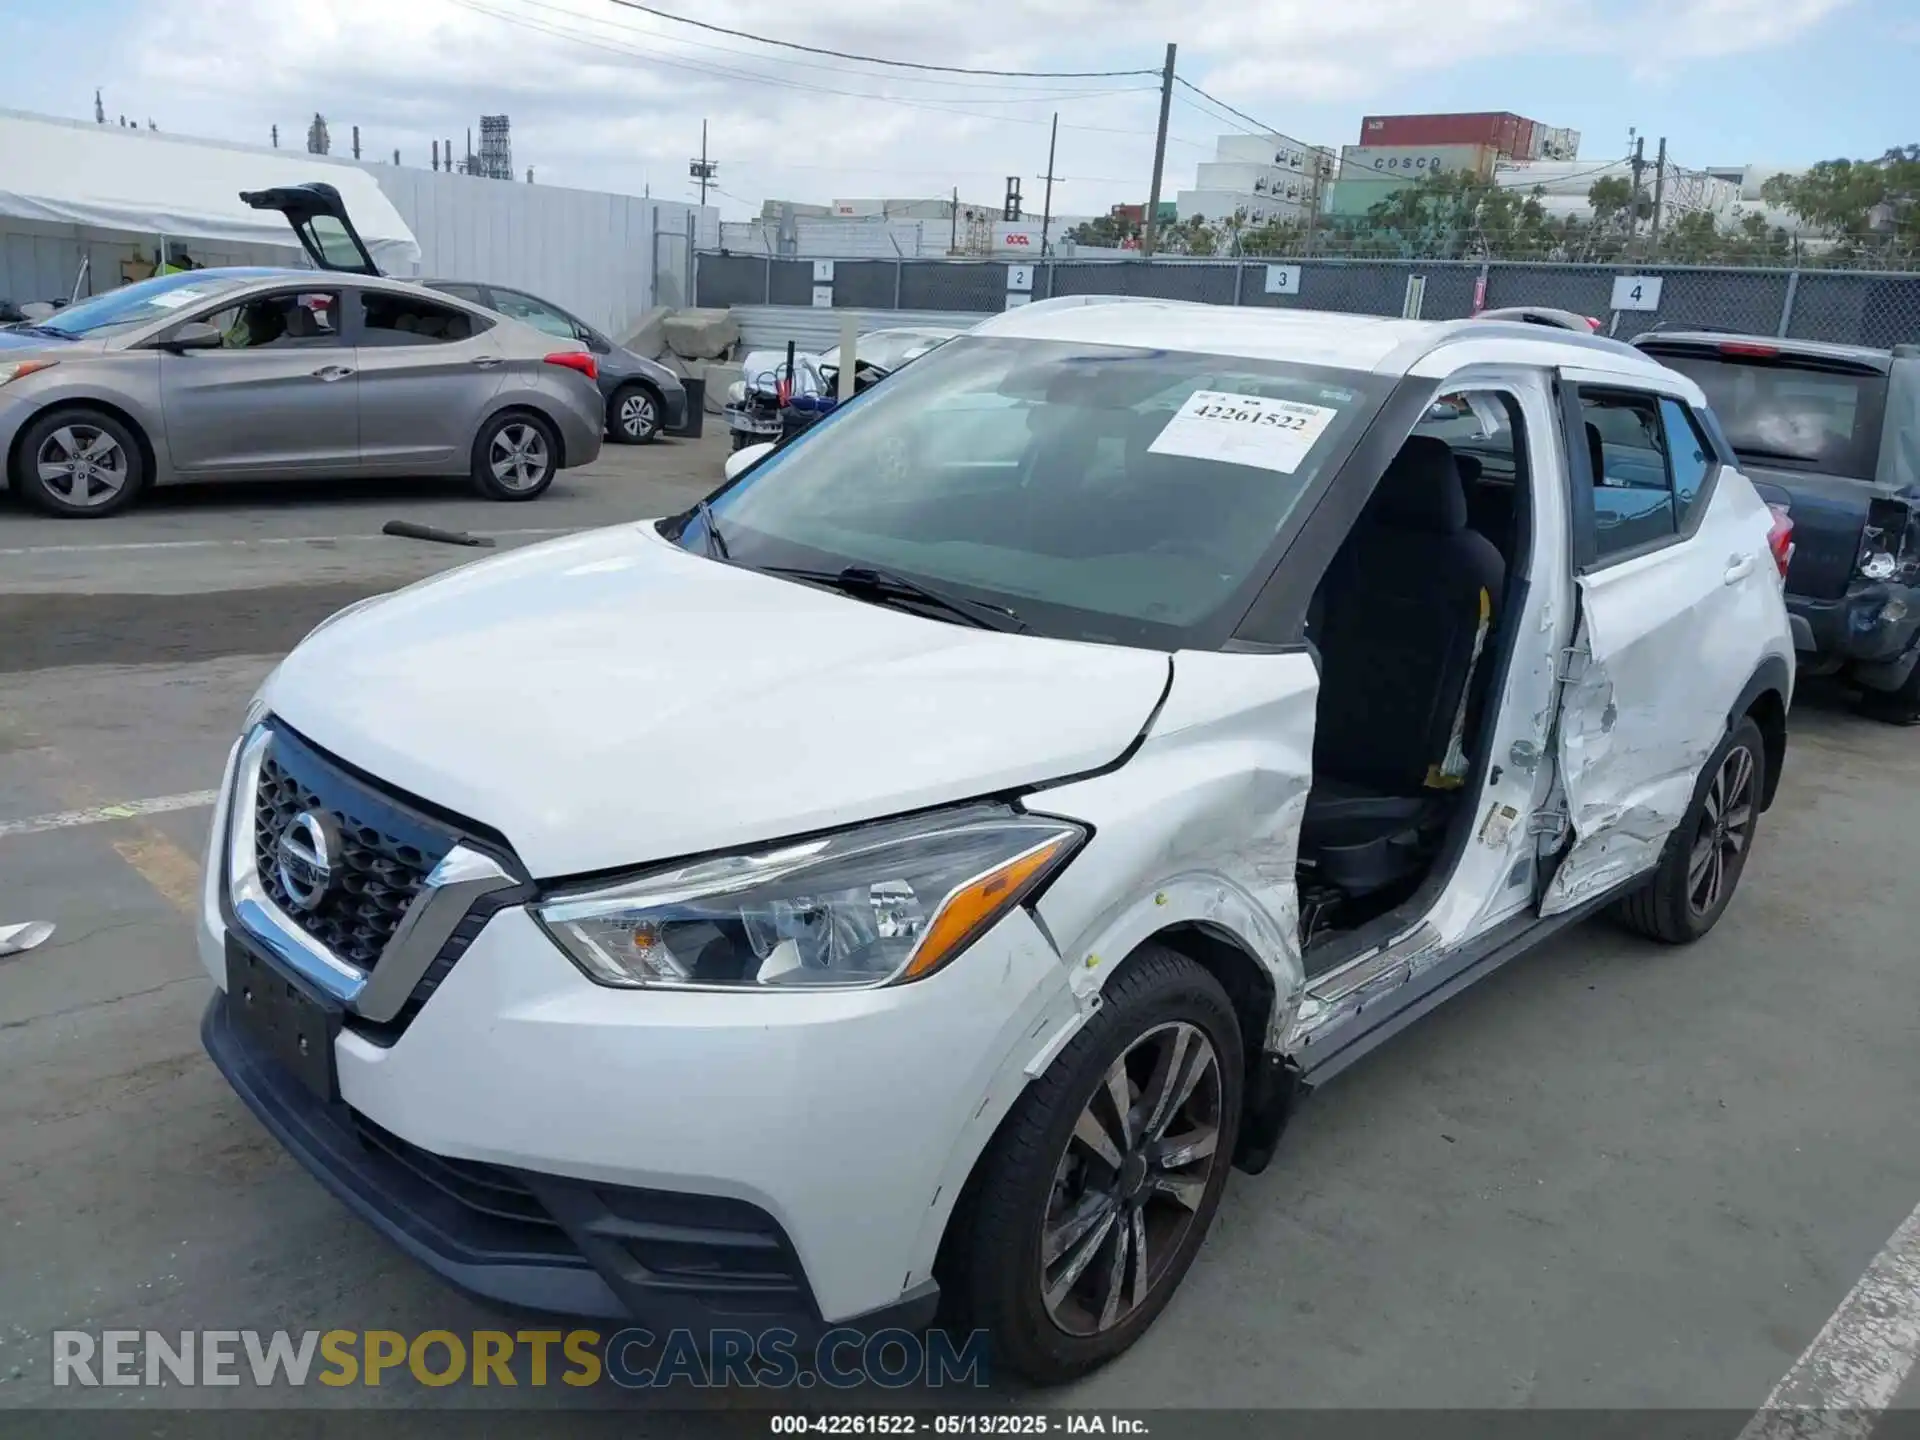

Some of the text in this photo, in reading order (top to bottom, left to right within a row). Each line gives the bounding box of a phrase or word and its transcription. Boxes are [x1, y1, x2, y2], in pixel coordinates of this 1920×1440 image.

[1374, 156, 1441, 170] COSCO
[822, 264, 827, 276] 1
[1016, 271, 1024, 284] 2
[1278, 271, 1288, 287] 3
[1630, 285, 1643, 302] 4
[1194, 403, 1307, 431] 42261522
